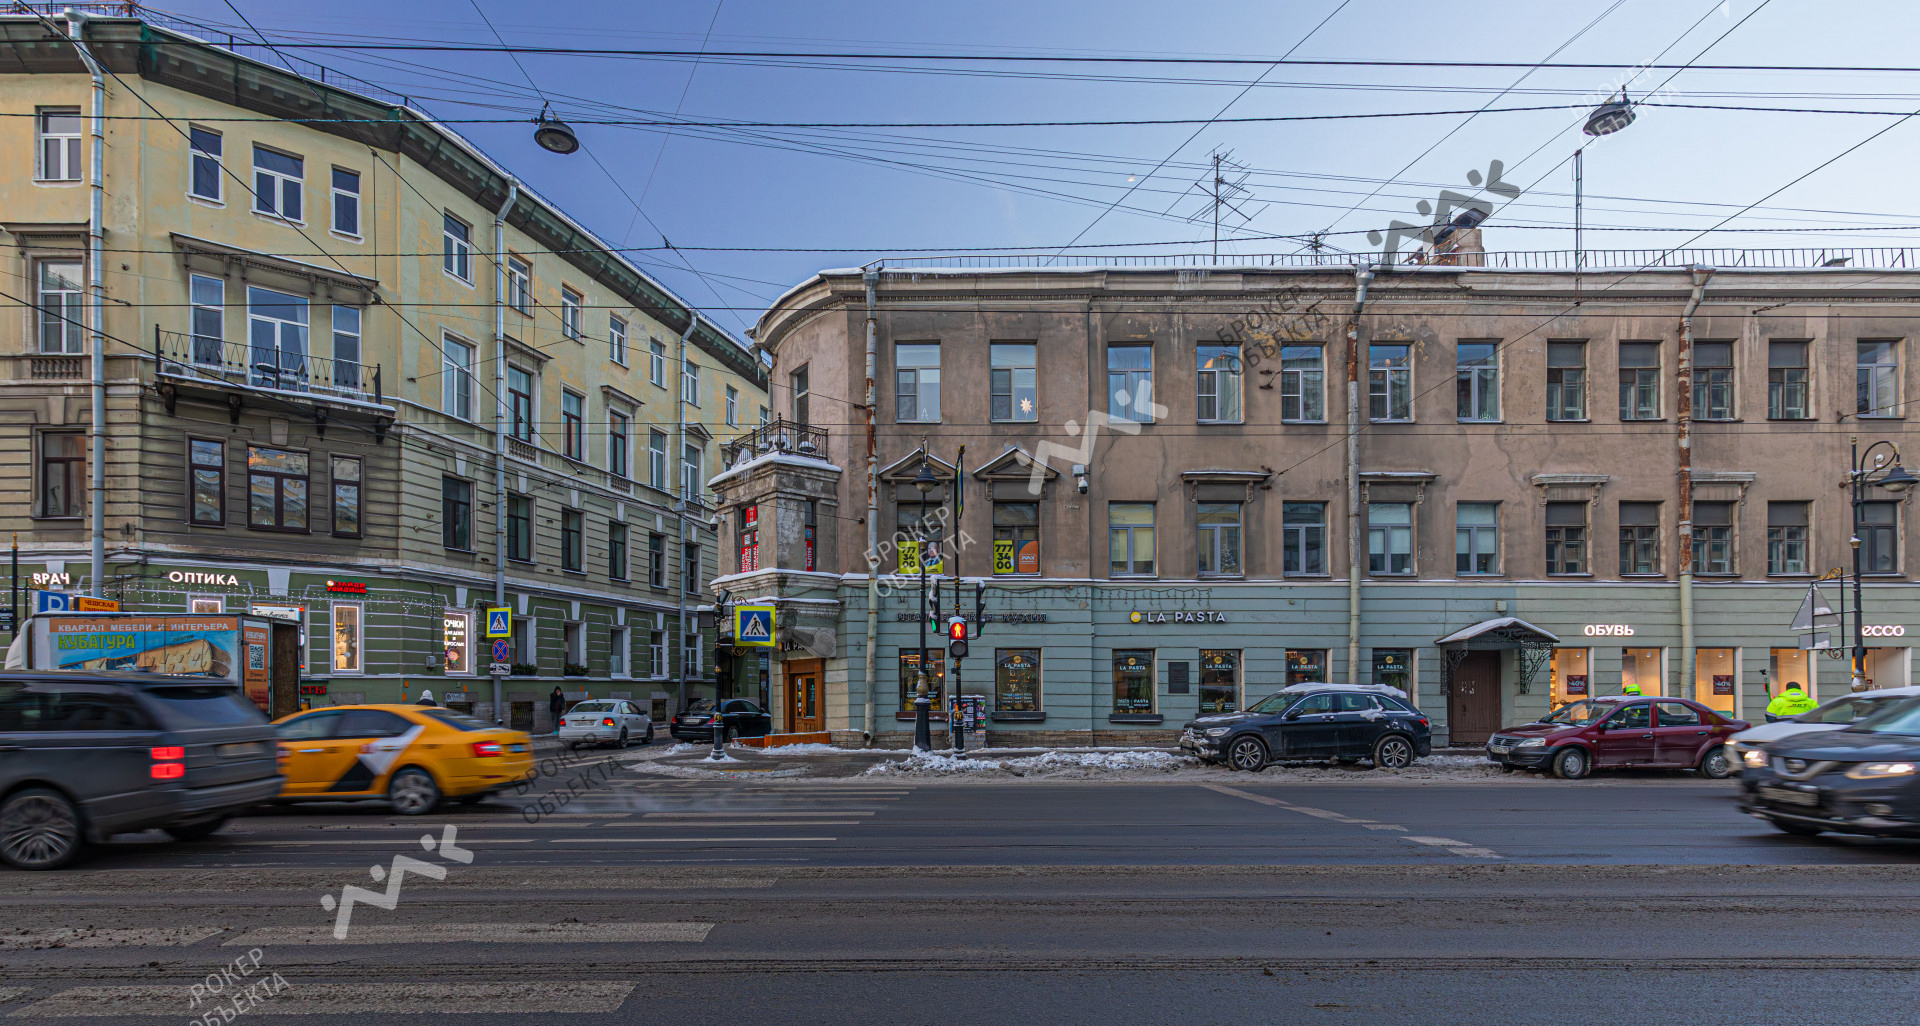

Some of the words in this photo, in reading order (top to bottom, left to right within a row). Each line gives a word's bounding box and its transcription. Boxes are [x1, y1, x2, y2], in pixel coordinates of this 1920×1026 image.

[995, 544, 1013, 552] 777
[997, 552, 1011, 561] 34
[996, 561, 1012, 570] 00
[33, 572, 70, 585] ВРАЧ
[168, 571, 239, 586] ОПТИКА
[326, 586, 368, 594] УВИДИШЬ
[84, 599, 115, 608] ЧЕШСКАЯ
[1147, 611, 1166, 622] LA
[1175, 611, 1226, 622] PASTA
[58, 624, 104, 632] КВАРТАЛ
[158, 623, 165, 631] И
[170, 623, 229, 631] ИНТЕРЬЕРА
[444, 619, 464, 629] ОЧКИ
[1584, 624, 1635, 636] ОБУВЬ
[1861, 625, 1905, 637] ecco
[58, 634, 135, 650] КУБАТУРА
